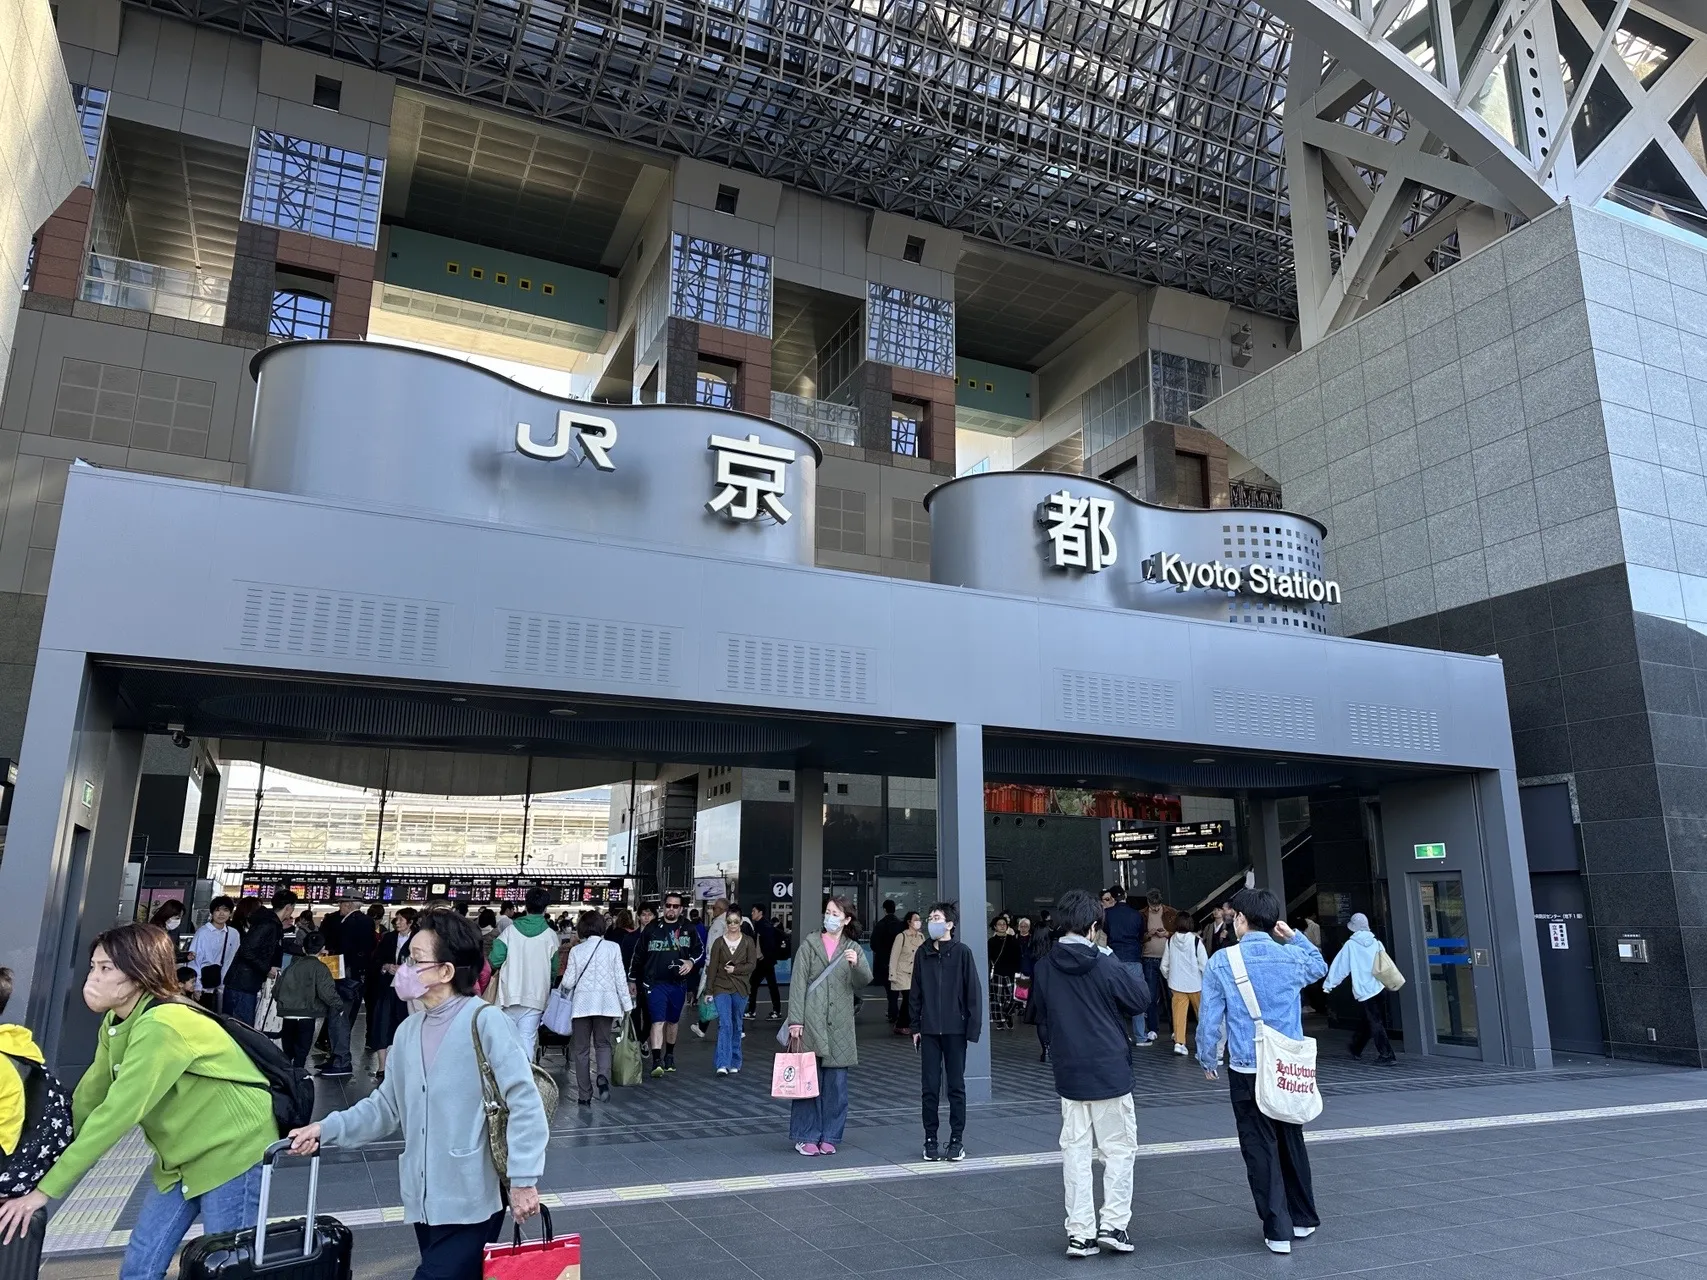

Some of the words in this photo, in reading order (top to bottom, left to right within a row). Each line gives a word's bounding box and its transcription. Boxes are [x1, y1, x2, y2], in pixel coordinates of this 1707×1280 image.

[515, 410, 617, 472] JR
[705, 434, 795, 524] 京
[1045, 490, 1117, 573] 都
[1159, 551, 1241, 591] Kyoto
[1249, 563, 1341, 603] Station
[1277, 1076, 1308, 1093] Athletic
